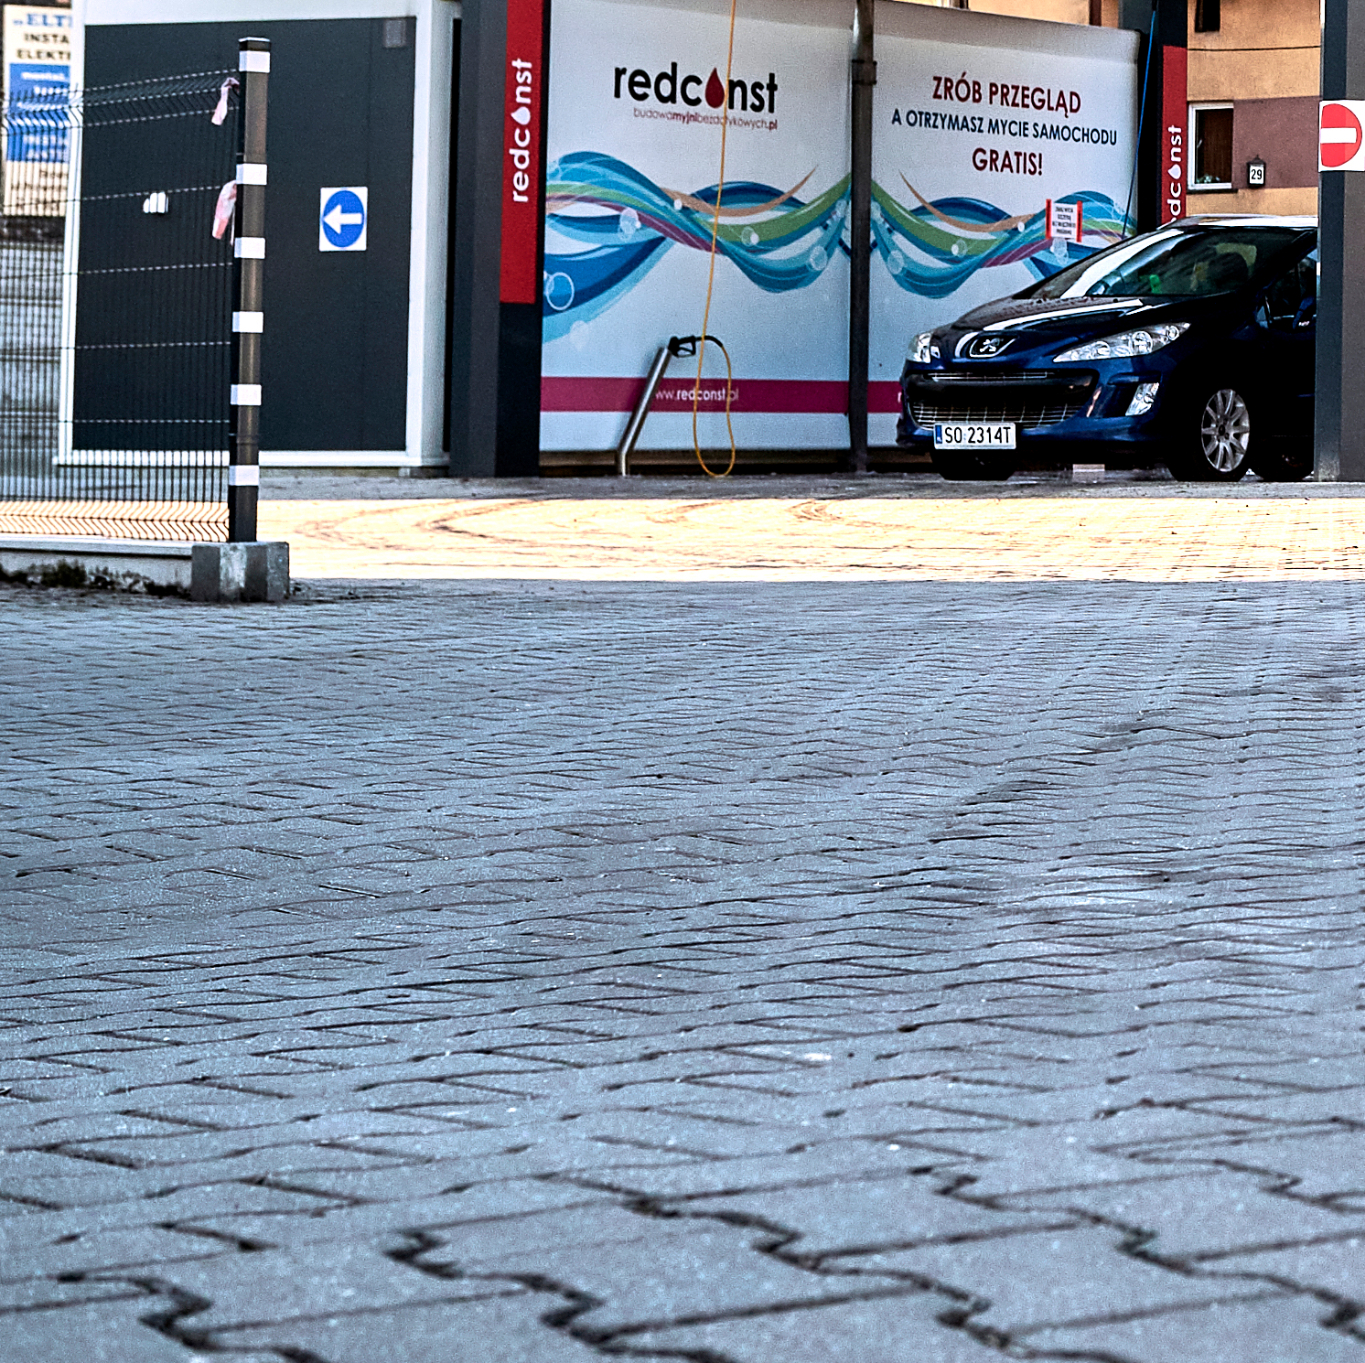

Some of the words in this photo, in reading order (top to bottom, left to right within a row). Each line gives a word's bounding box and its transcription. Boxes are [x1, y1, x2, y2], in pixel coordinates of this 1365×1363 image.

[24, 33, 69, 44] INSTA
[932, 72, 982, 103] ZRÓB
[988, 82, 1081, 119] PRZEGLĄD
[891, 108, 901, 125] A
[906, 110, 984, 134] OTRZYMASZ
[987, 118, 1029, 138] MYCIE
[1032, 122, 1117, 146] SAMOCHODU
[972, 147, 1043, 176] GRATIS!
[1251, 169, 1262, 180] 29
[944, 426, 963, 444] SO
[967, 426, 1011, 444] 2314T
